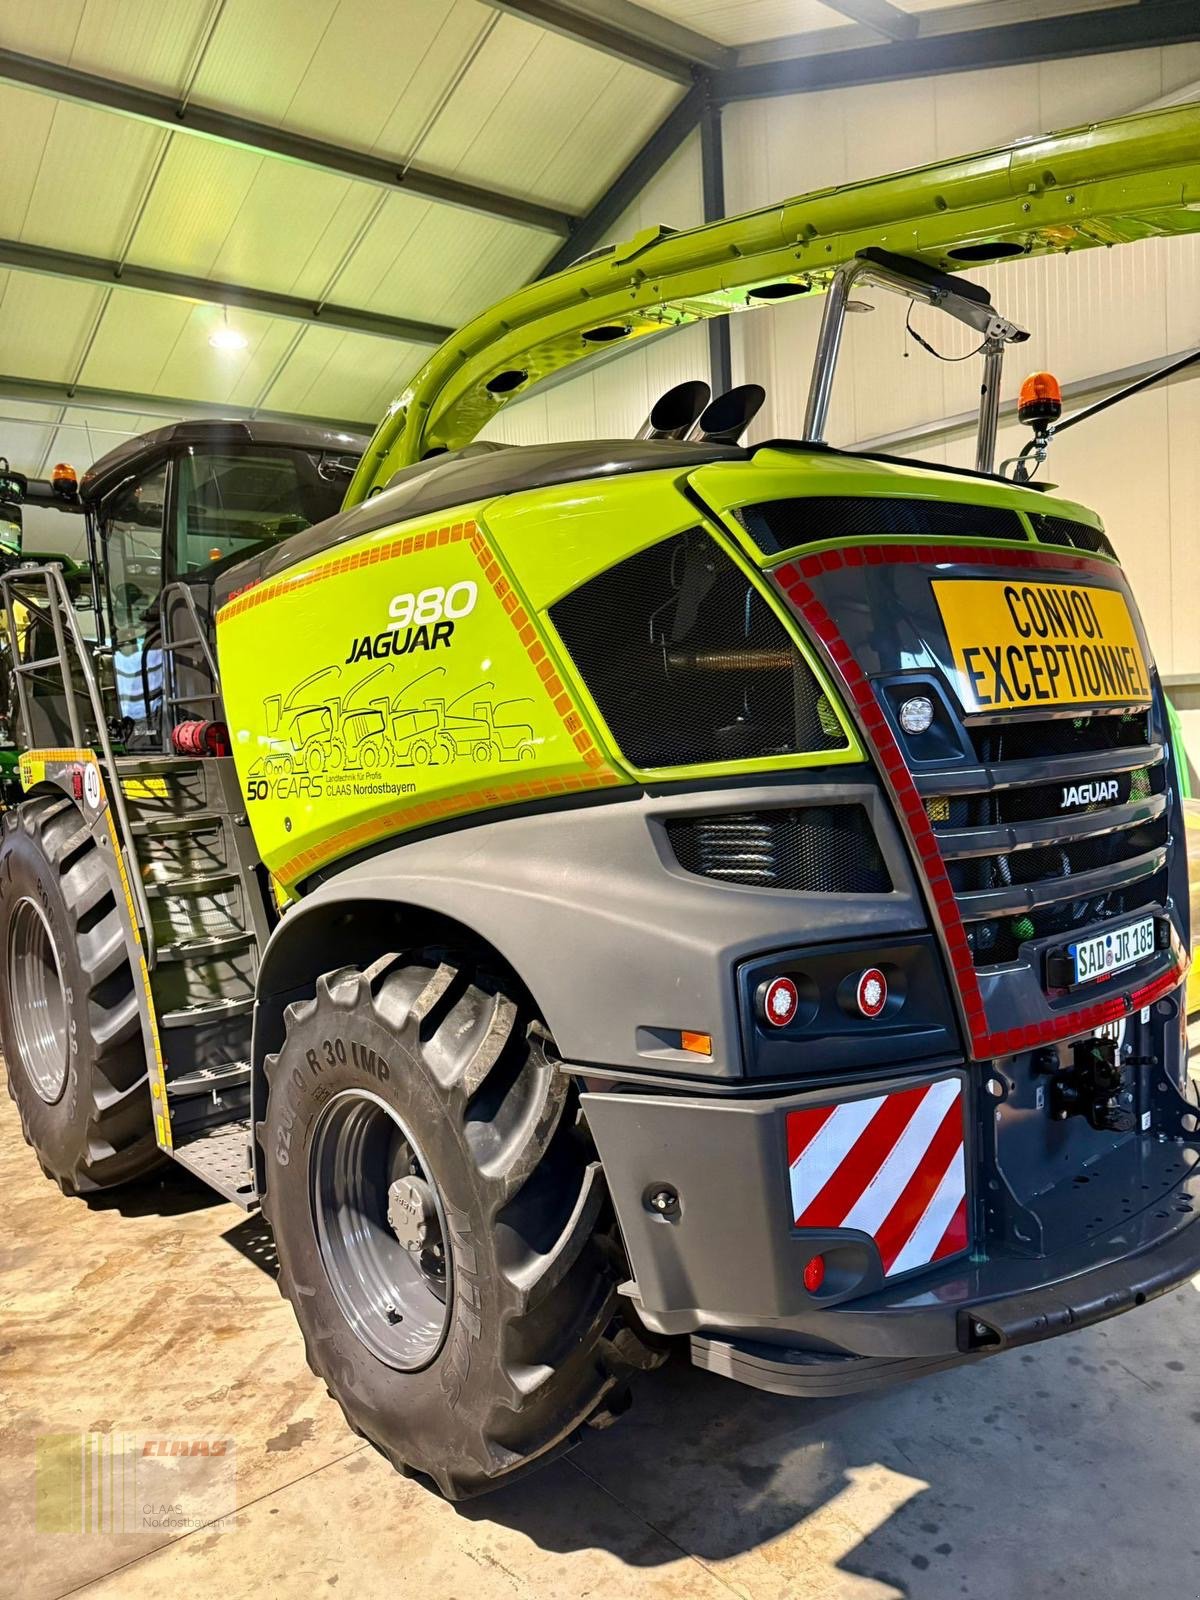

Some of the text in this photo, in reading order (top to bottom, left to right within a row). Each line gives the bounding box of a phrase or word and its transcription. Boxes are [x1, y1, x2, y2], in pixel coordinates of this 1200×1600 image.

[387, 580, 478, 631] 980
[1003, 585, 1104, 639] CONVOI
[345, 620, 455, 664] JAGUAR
[962, 643, 1149, 705] EXCEPTIONNEL
[88, 770, 97, 799] 40
[326, 771, 382, 783] Landtechnik für Profis
[326, 782, 416, 797] CLAAS Nordostbayern
[1060, 780, 1119, 808] JAGUAR
[1079, 922, 1154, 977] SAD JR 185
[305, 1048, 323, 1077] R
[323, 1038, 348, 1068] 30
[351, 1040, 390, 1082] IMP
